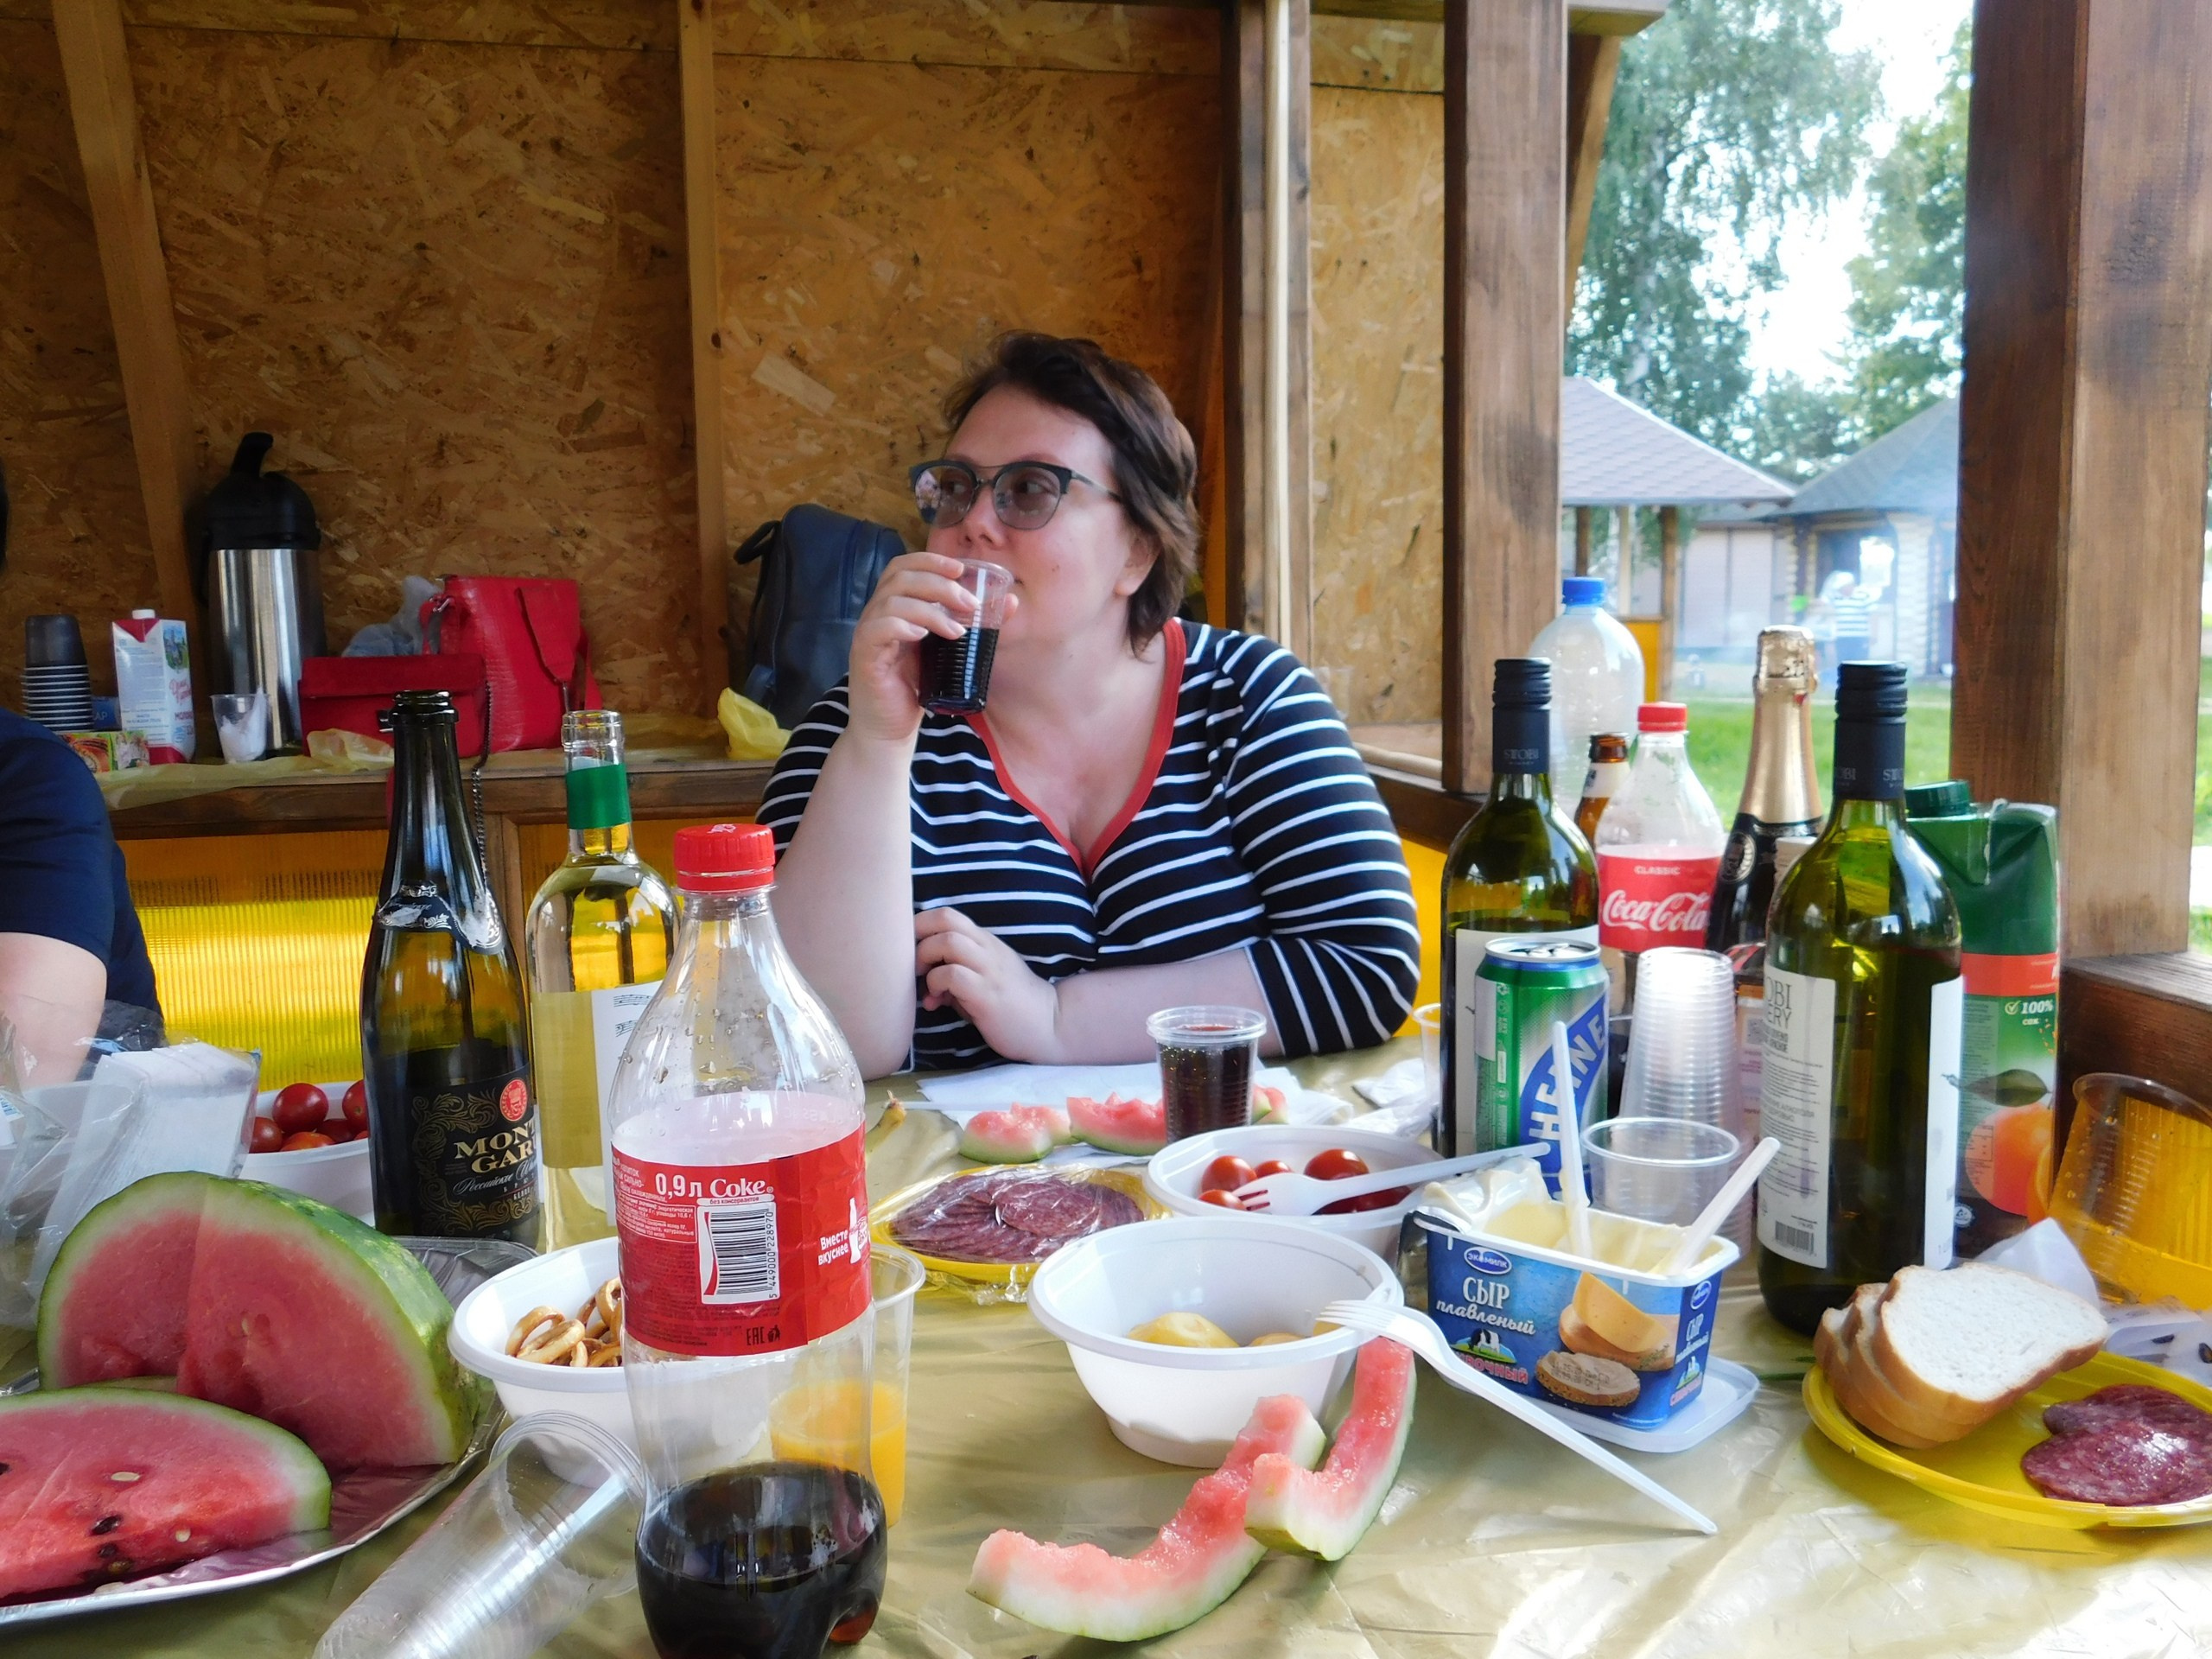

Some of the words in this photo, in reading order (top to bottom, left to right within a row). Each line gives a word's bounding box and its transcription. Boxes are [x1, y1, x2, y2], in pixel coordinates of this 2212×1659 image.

[1882, 767, 1904, 781] ST
[1634, 865, 1681, 875] CLASSIC
[1602, 889, 1712, 932] Coca-Cola
[2021, 999, 2054, 1014] 100%
[655, 1173, 686, 1199] 0,9
[688, 1181, 702, 1198] л
[709, 1178, 766, 1198] Coke
[766, 1211, 776, 1248] 228970
[820, 1229, 849, 1251] Вместе
[766, 1251, 777, 1287] 449000
[817, 1243, 849, 1266] вкуснее
[1462, 1276, 1510, 1310] СЫР
[1435, 1300, 1536, 1335] плавленый
[1455, 1351, 1529, 1385] ВОЧНЫЙ
